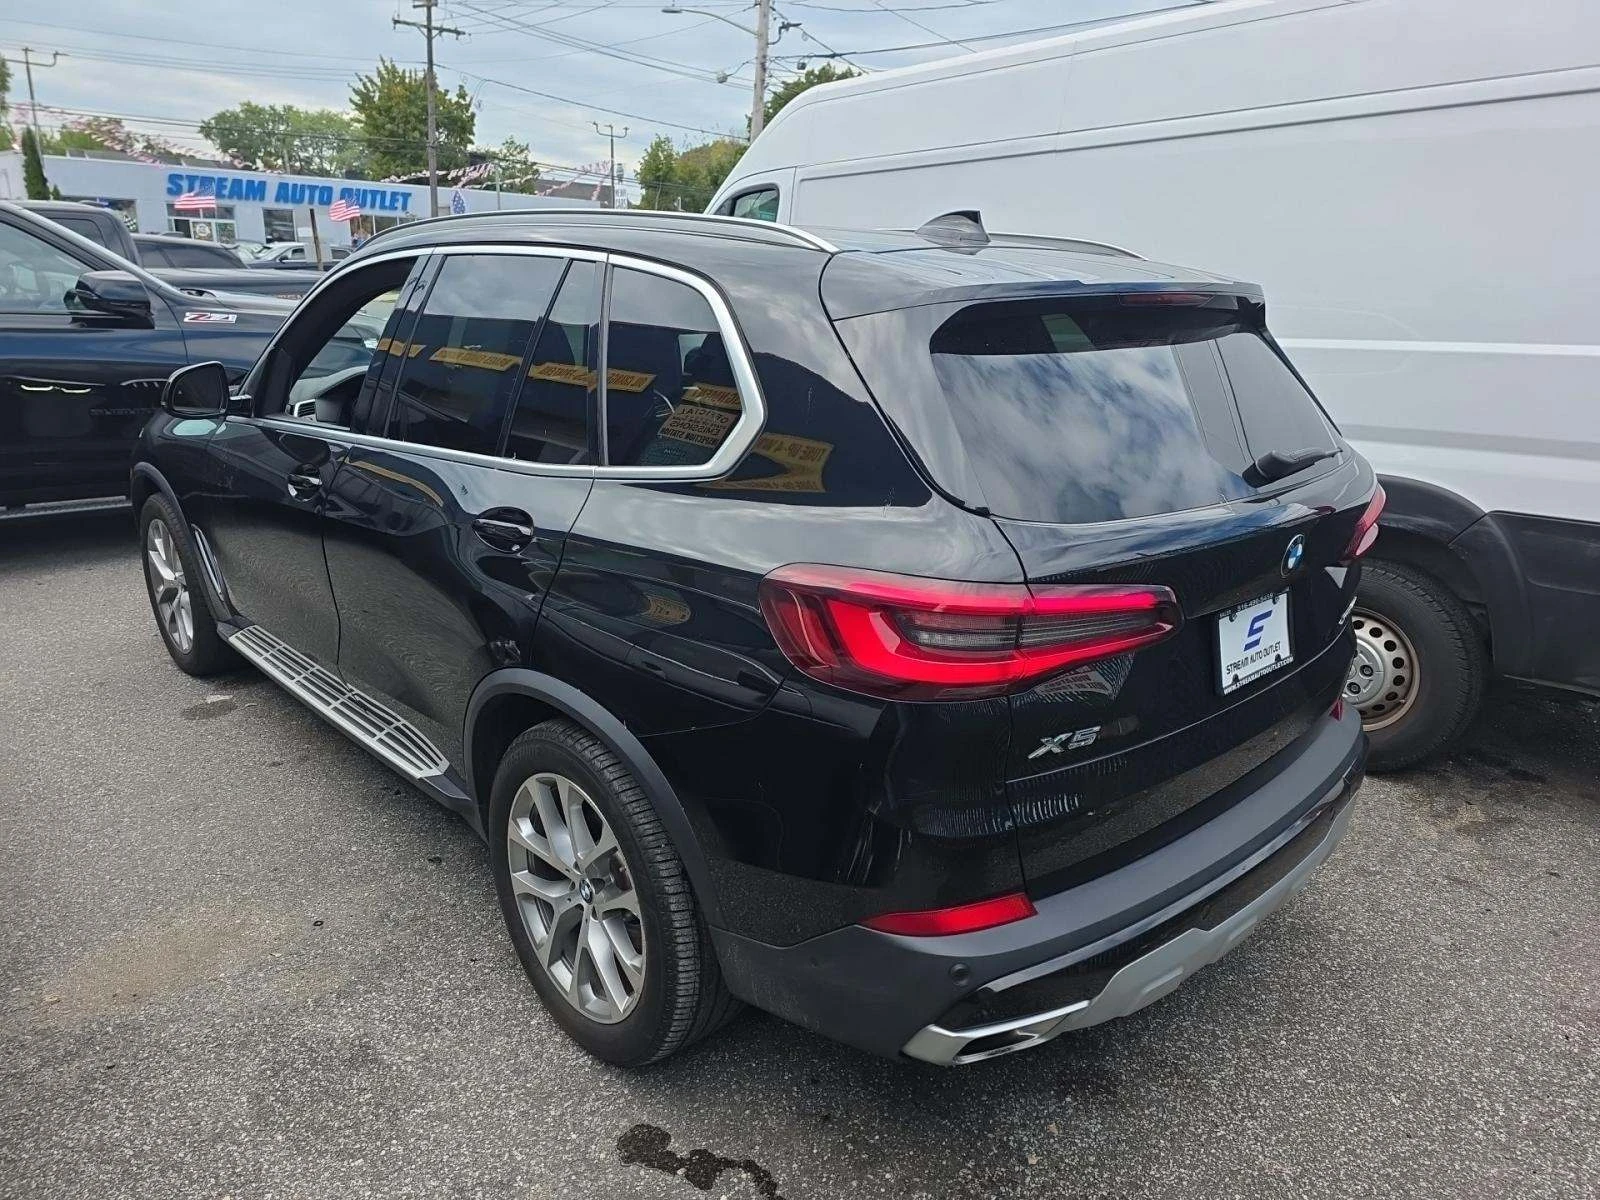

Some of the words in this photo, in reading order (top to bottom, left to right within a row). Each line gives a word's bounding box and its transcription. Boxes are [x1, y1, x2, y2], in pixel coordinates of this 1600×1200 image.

[275, 182, 333, 205] AUTO
[1226, 656, 1250, 675] STREAM
[1250, 650, 1262, 664] AUTO
[1263, 641, 1281, 659] OUTLET
[1027, 725, 1102, 759] X5
